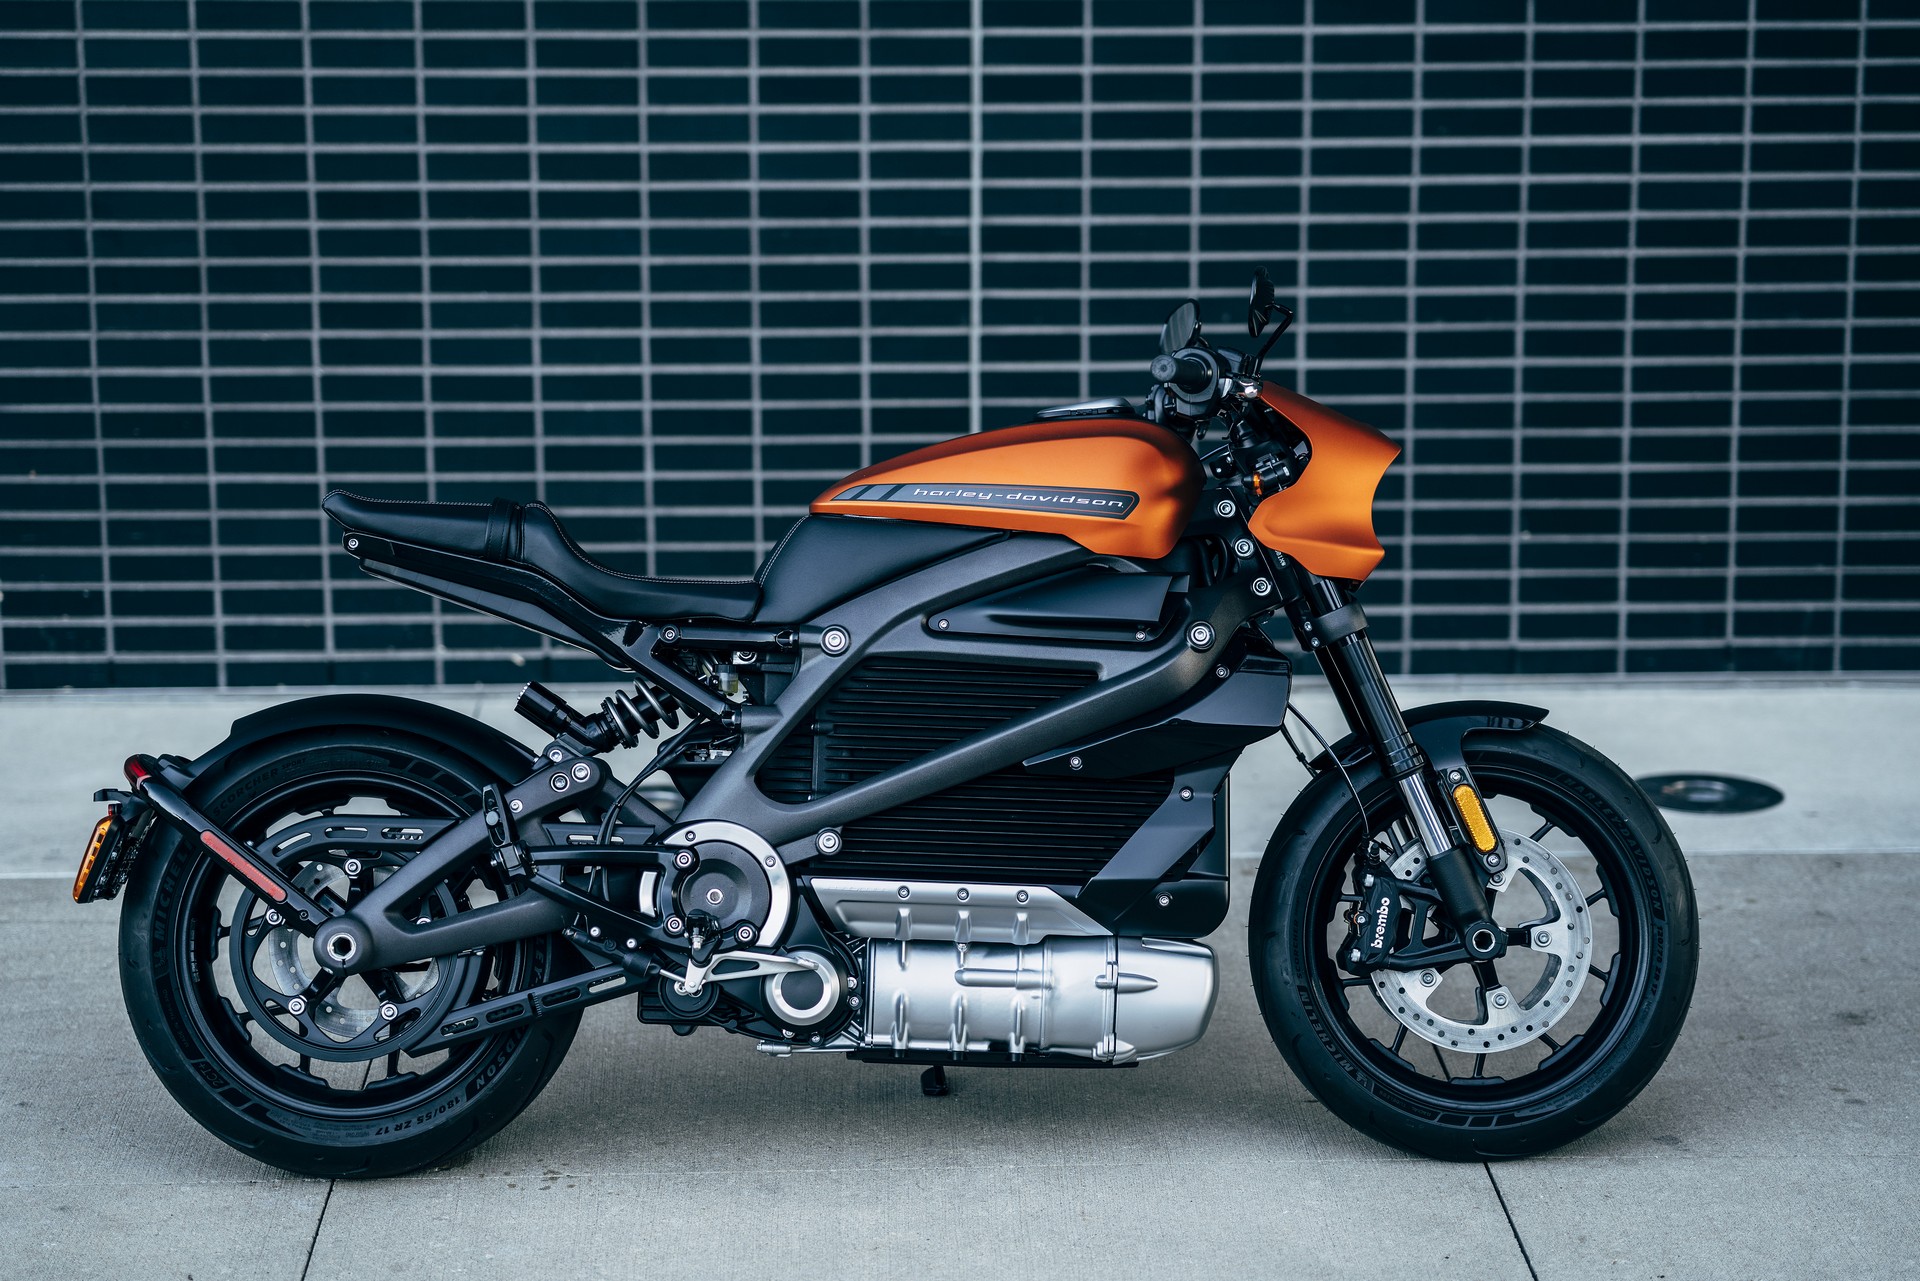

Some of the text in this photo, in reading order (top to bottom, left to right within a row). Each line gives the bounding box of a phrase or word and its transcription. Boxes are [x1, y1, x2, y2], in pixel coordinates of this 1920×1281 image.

[212, 757, 306, 816] SCORCHER SPORT
[1563, 777, 1662, 912] HARLEY-DAVIDSON
[153, 839, 195, 941] MICHELI
[1370, 897, 1390, 949] brembo
[1656, 926, 1664, 963] 120/70
[1299, 990, 1354, 1074] MICHELIN
[198, 1062, 225, 1089] 2CT+
[374, 1125, 391, 1136] 17
[394, 1118, 413, 1132] ZR
[416, 1095, 462, 1125] 180/55
